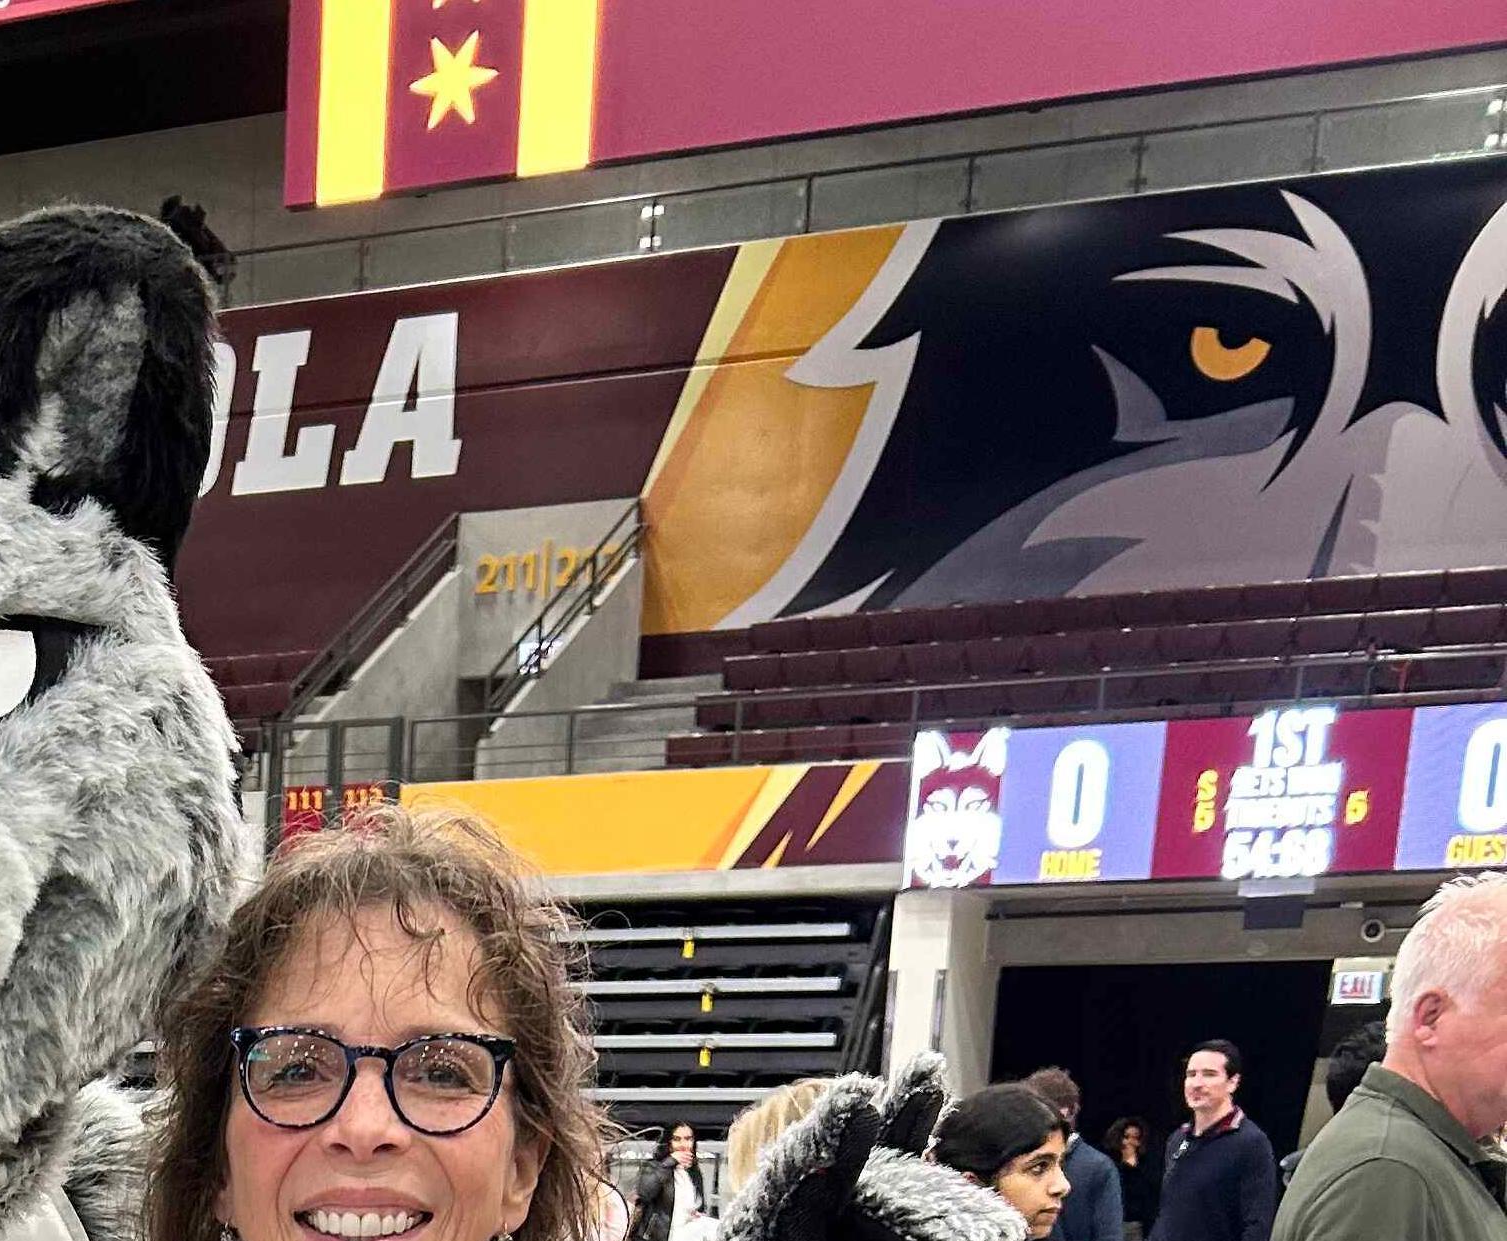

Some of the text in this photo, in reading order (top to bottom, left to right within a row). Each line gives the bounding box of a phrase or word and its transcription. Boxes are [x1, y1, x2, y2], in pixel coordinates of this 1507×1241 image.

[1247, 705, 1339, 768] 1ST
[1046, 738, 1109, 849] 0
[1039, 848, 1103, 880] HOME
